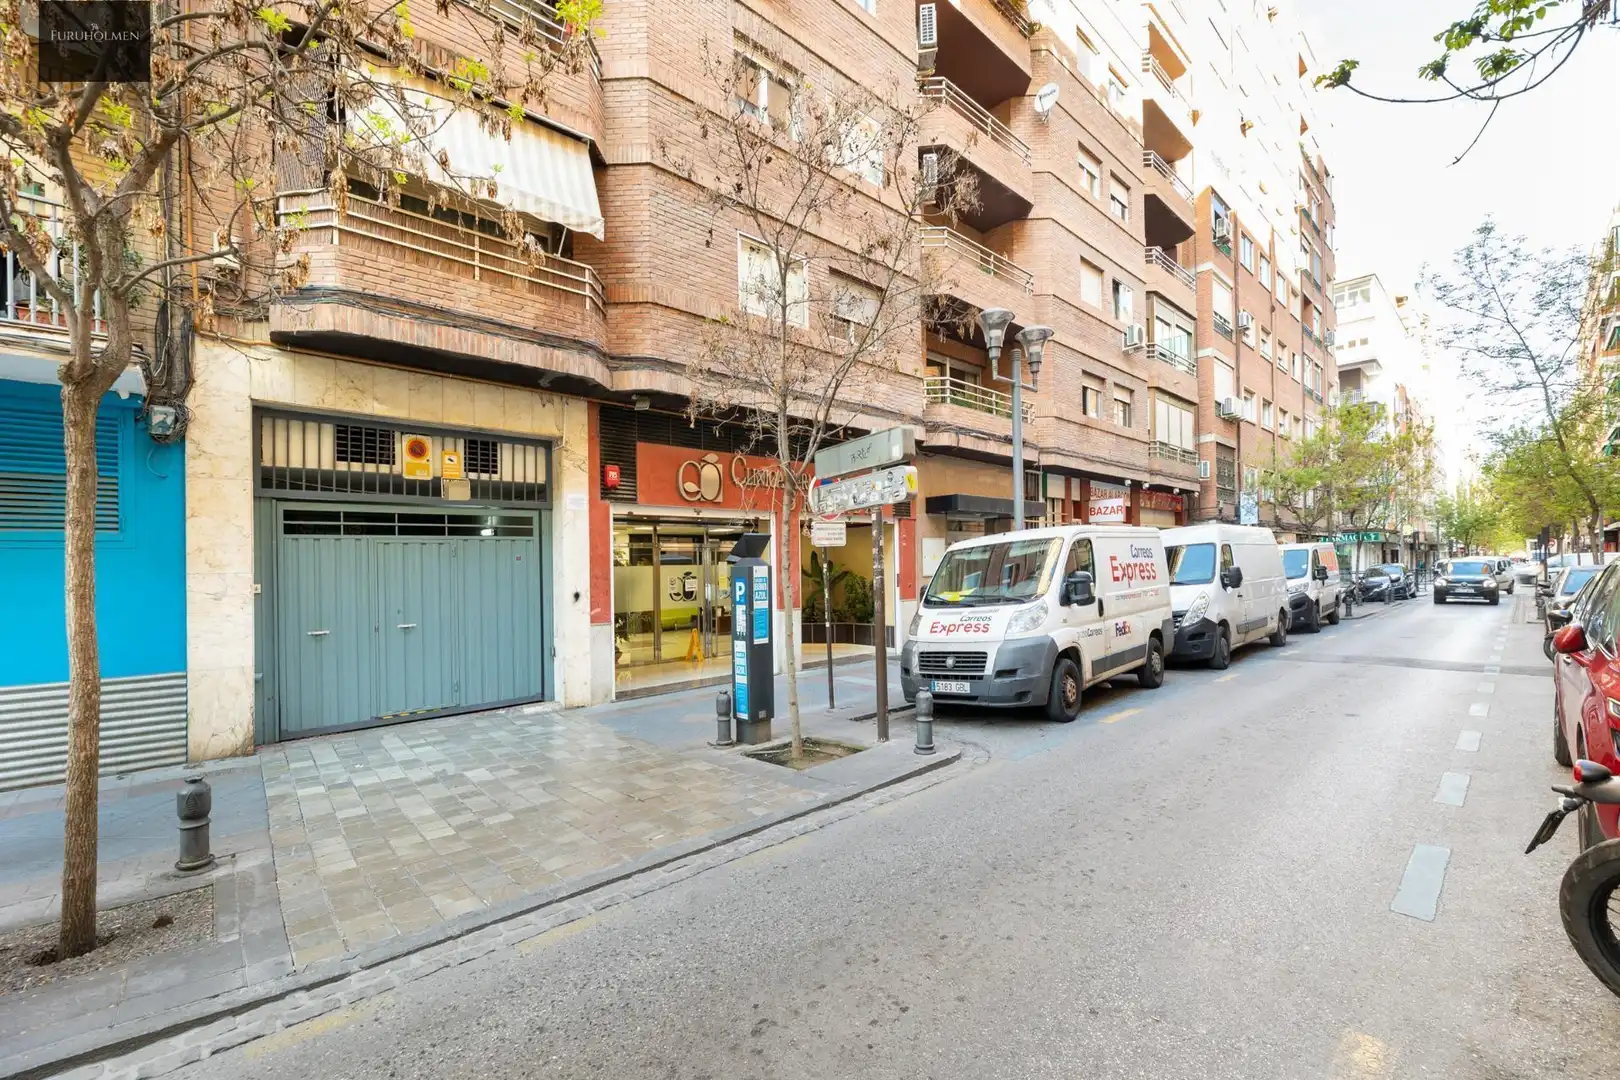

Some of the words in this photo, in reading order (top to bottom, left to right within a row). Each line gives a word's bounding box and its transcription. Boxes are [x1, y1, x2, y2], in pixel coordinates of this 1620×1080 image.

[1090, 485, 1108, 499] BAZAR
[1089, 505, 1124, 517] BAZAR
[1130, 544, 1153, 559] Correos
[1109, 555, 1157, 588] Express
[735, 581, 746, 602] P
[929, 621, 990, 636] Express
[1114, 621, 1132, 637] FedEx
[936, 682, 953, 692] 5183
[955, 683, 968, 692] GBL
